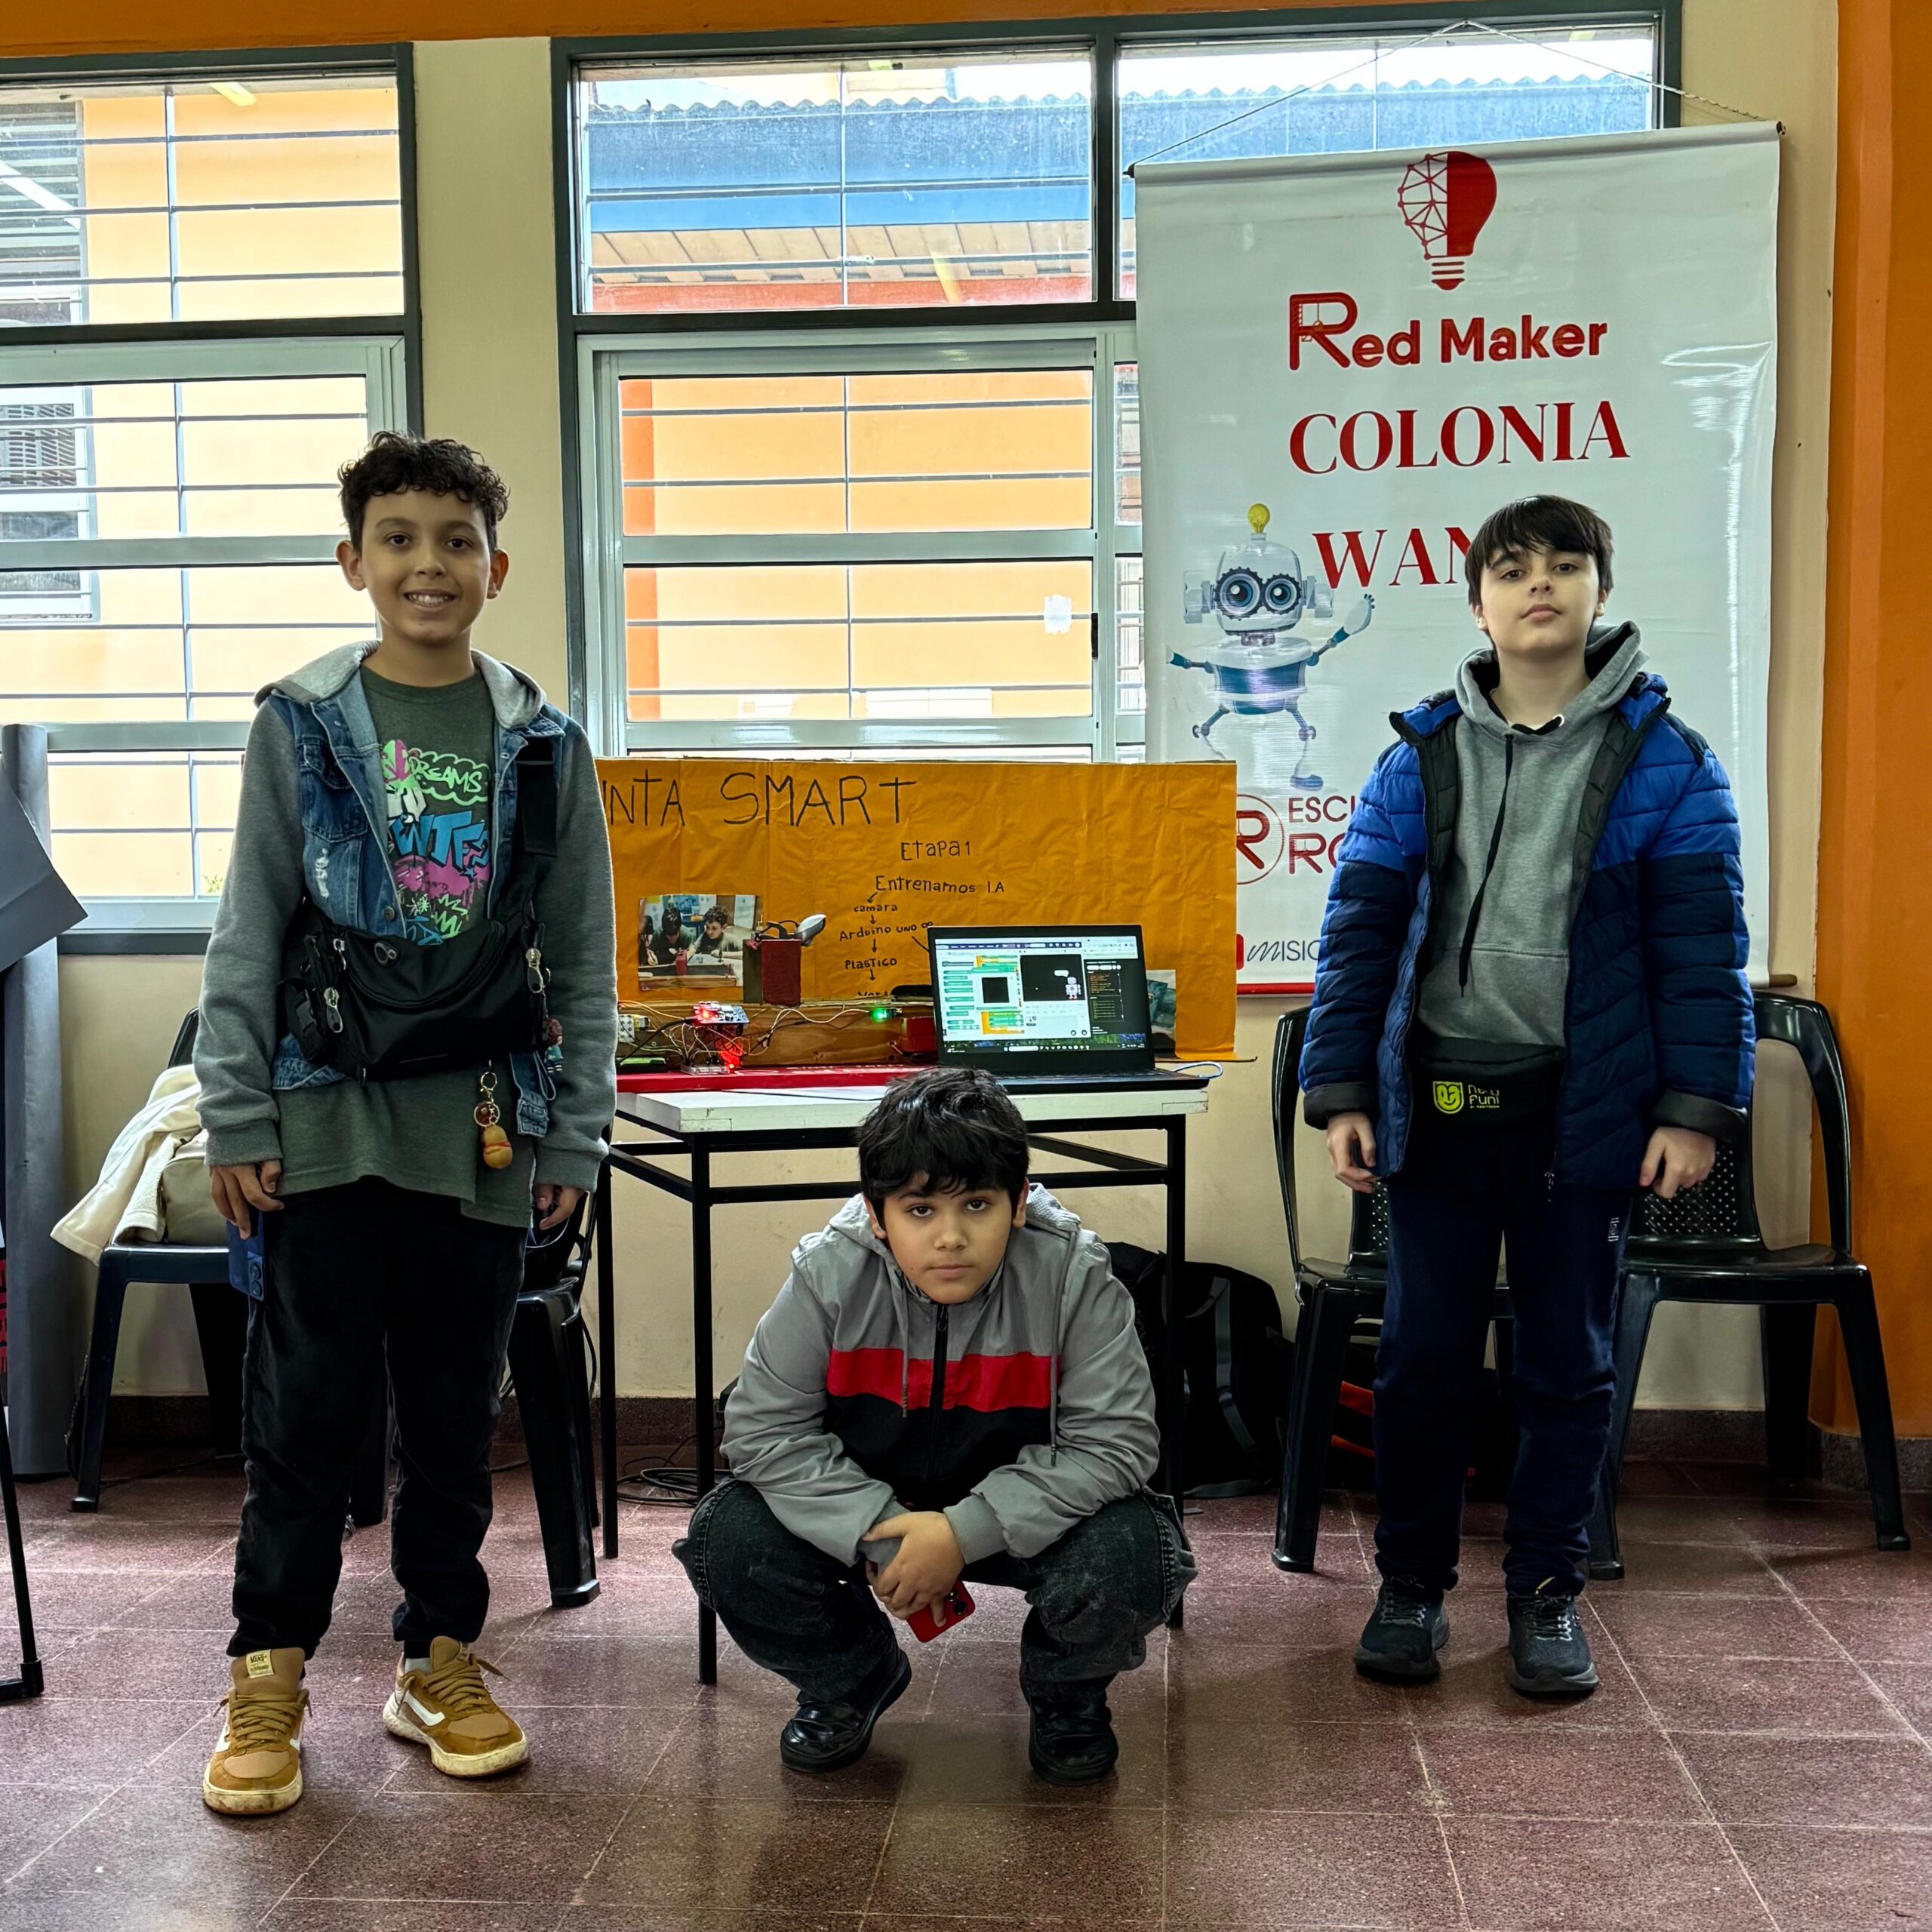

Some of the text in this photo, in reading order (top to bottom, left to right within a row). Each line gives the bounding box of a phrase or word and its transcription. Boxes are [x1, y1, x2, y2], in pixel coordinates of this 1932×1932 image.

[1289, 292, 1607, 371] Red Maker
[1289, 400, 1631, 474] COLONIA
[408, 756, 482, 792] DREAMS
[721, 772, 918, 827] SMART
[875, 875, 976, 894] Entrenamos
[839, 926, 891, 942] Arduino
